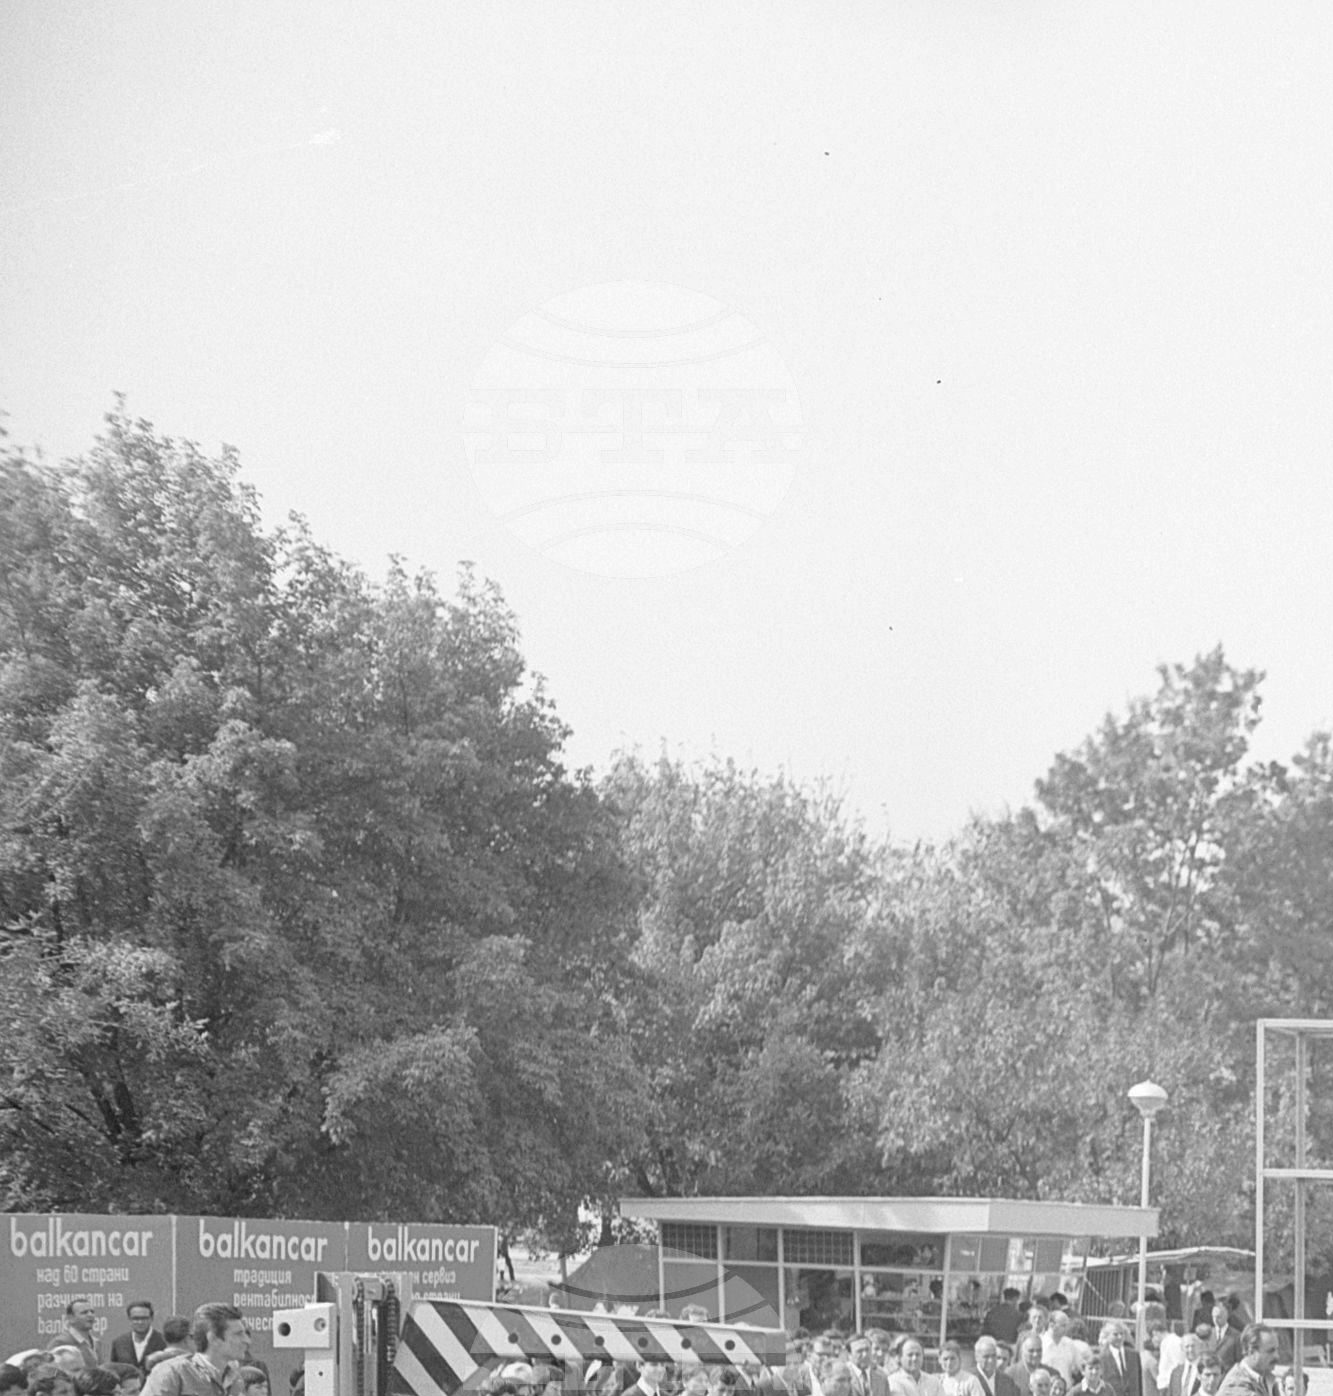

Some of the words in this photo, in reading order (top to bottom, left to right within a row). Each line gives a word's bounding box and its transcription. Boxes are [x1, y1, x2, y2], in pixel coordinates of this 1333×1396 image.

[10, 1217, 153, 1257] balkancar
[200, 1219, 328, 1262] balkancar
[367, 1225, 480, 1263] balkancar
[36, 1267, 60, 1287] над
[64, 1264, 79, 1284] 60
[81, 1266, 130, 1287] страни
[233, 1268, 292, 1288] традиция
[422, 1265, 457, 1288] сервиз
[108, 1292, 124, 1308] на
